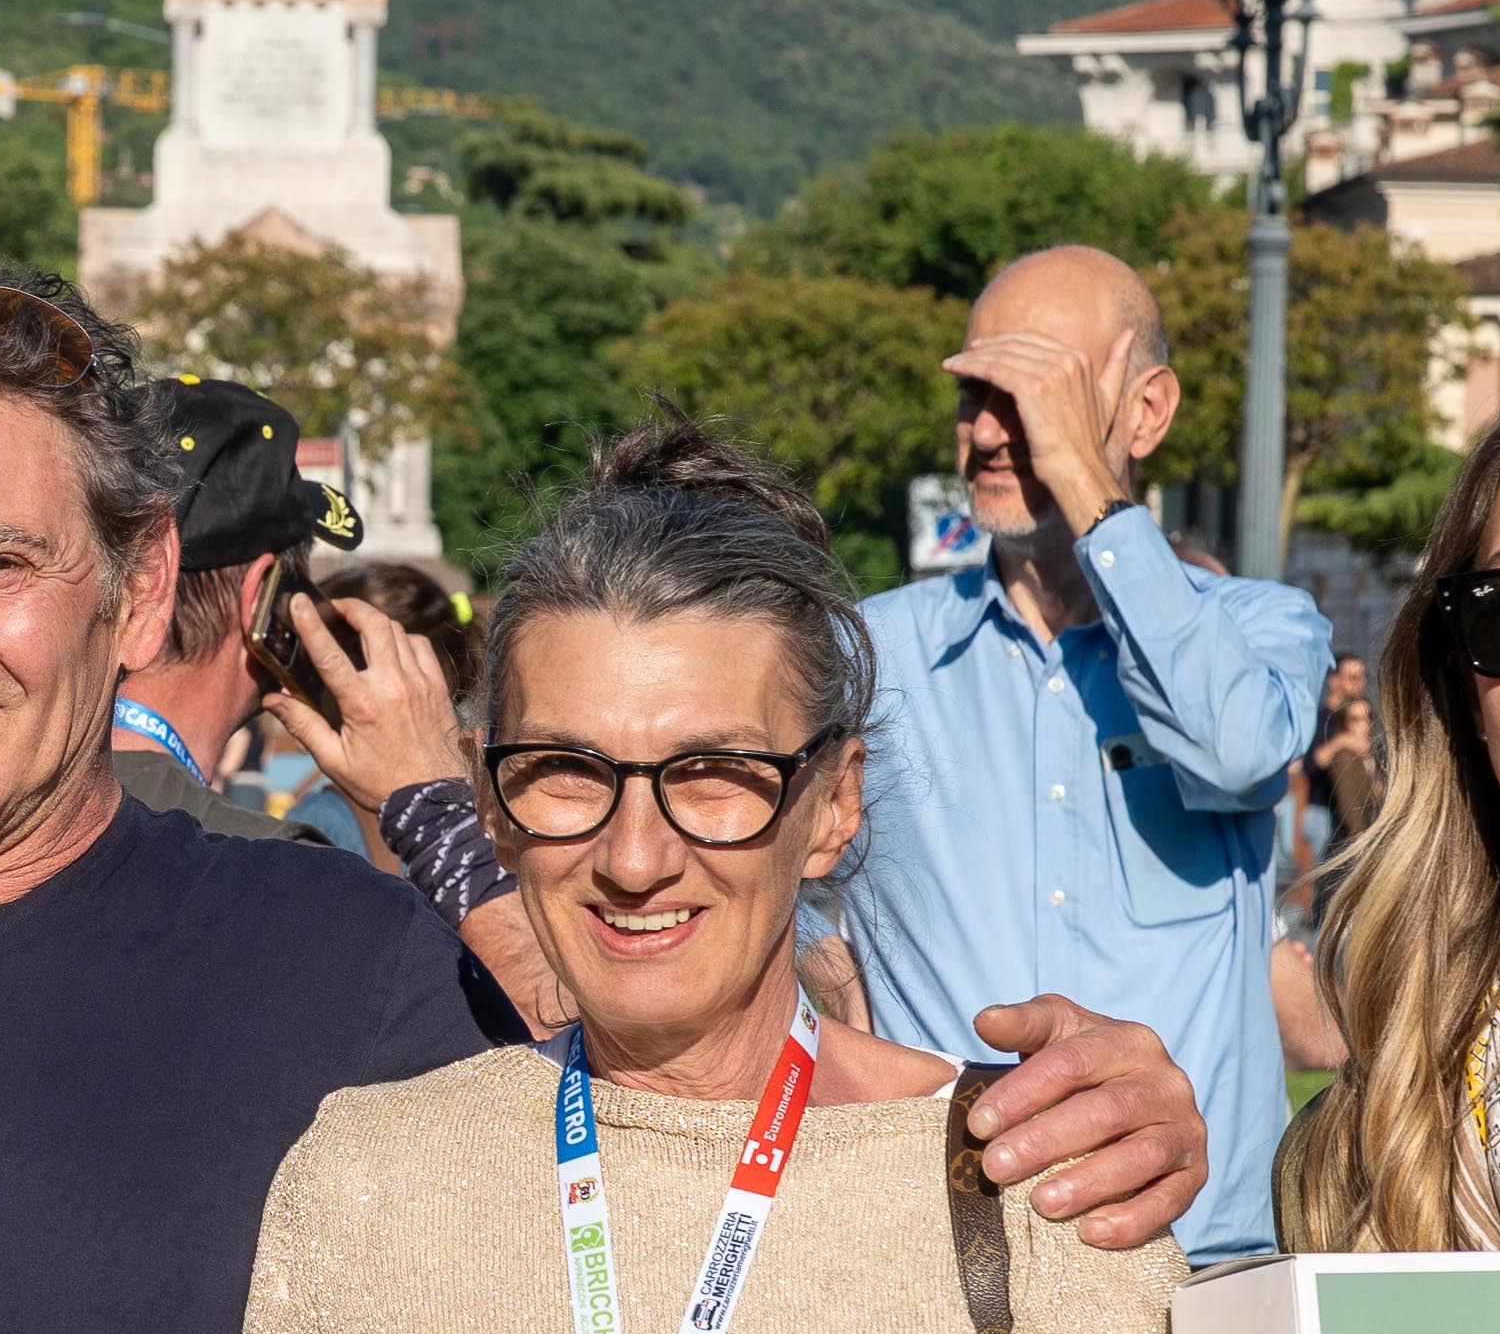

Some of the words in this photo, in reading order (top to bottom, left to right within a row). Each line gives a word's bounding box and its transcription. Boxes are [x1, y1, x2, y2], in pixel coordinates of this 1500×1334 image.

[125, 707, 168, 741] CASA
[563, 1069, 588, 1146] FILTRO
[763, 1063, 801, 1143] Euromedical
[699, 1210, 739, 1296] CARROZZERIA
[711, 1212, 753, 1299] MERIGHETTI
